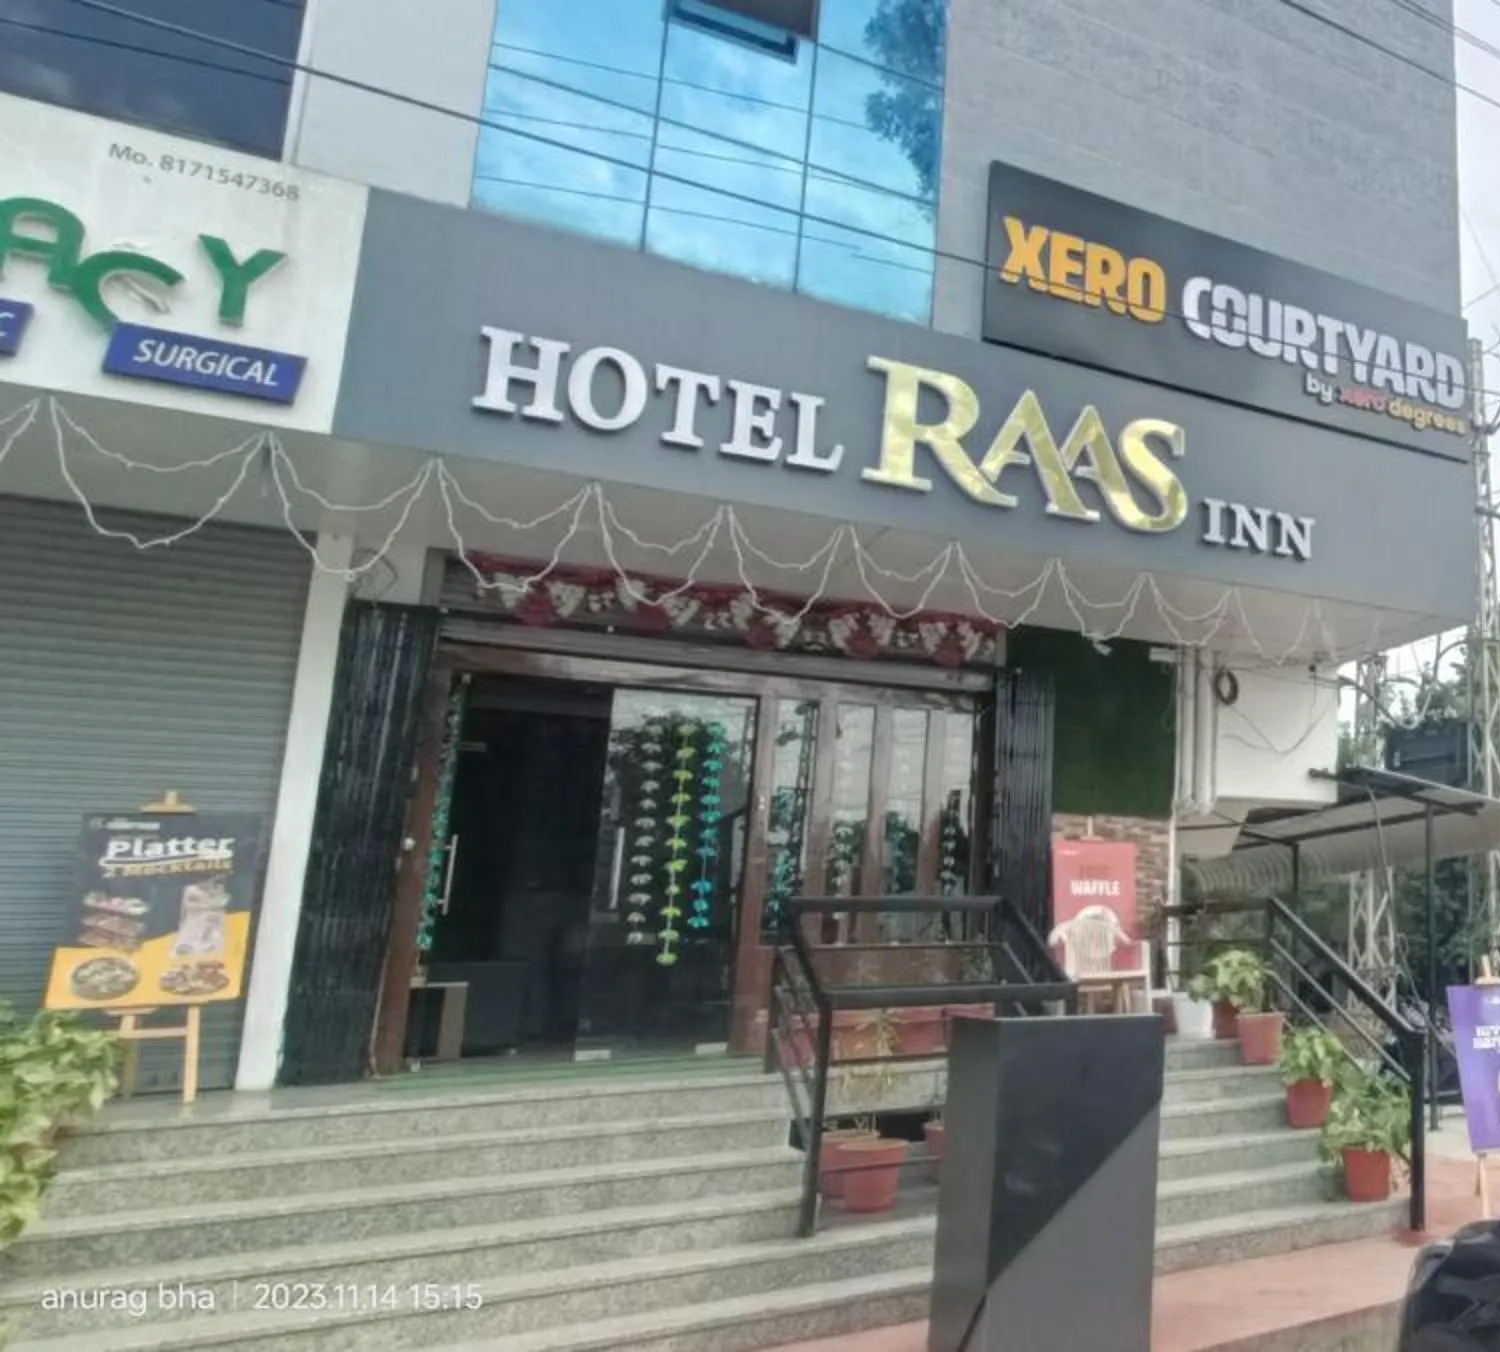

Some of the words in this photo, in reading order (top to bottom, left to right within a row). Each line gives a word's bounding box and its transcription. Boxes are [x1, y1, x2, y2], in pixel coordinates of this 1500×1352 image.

[108, 143, 153, 167] Mo.
[160, 154, 302, 201] 8171547368
[1000, 215, 1167, 324] XERO
[1182, 275, 1467, 410] COURTYARD
[133, 339, 279, 386] SURGICAL
[1305, 372, 1332, 404] by
[471, 326, 844, 472] HOTEL
[861, 355, 1187, 533] RAAS
[1202, 497, 1315, 561] INN
[104, 836, 236, 860] Platter
[1070, 880, 1120, 896] WAFFLE
